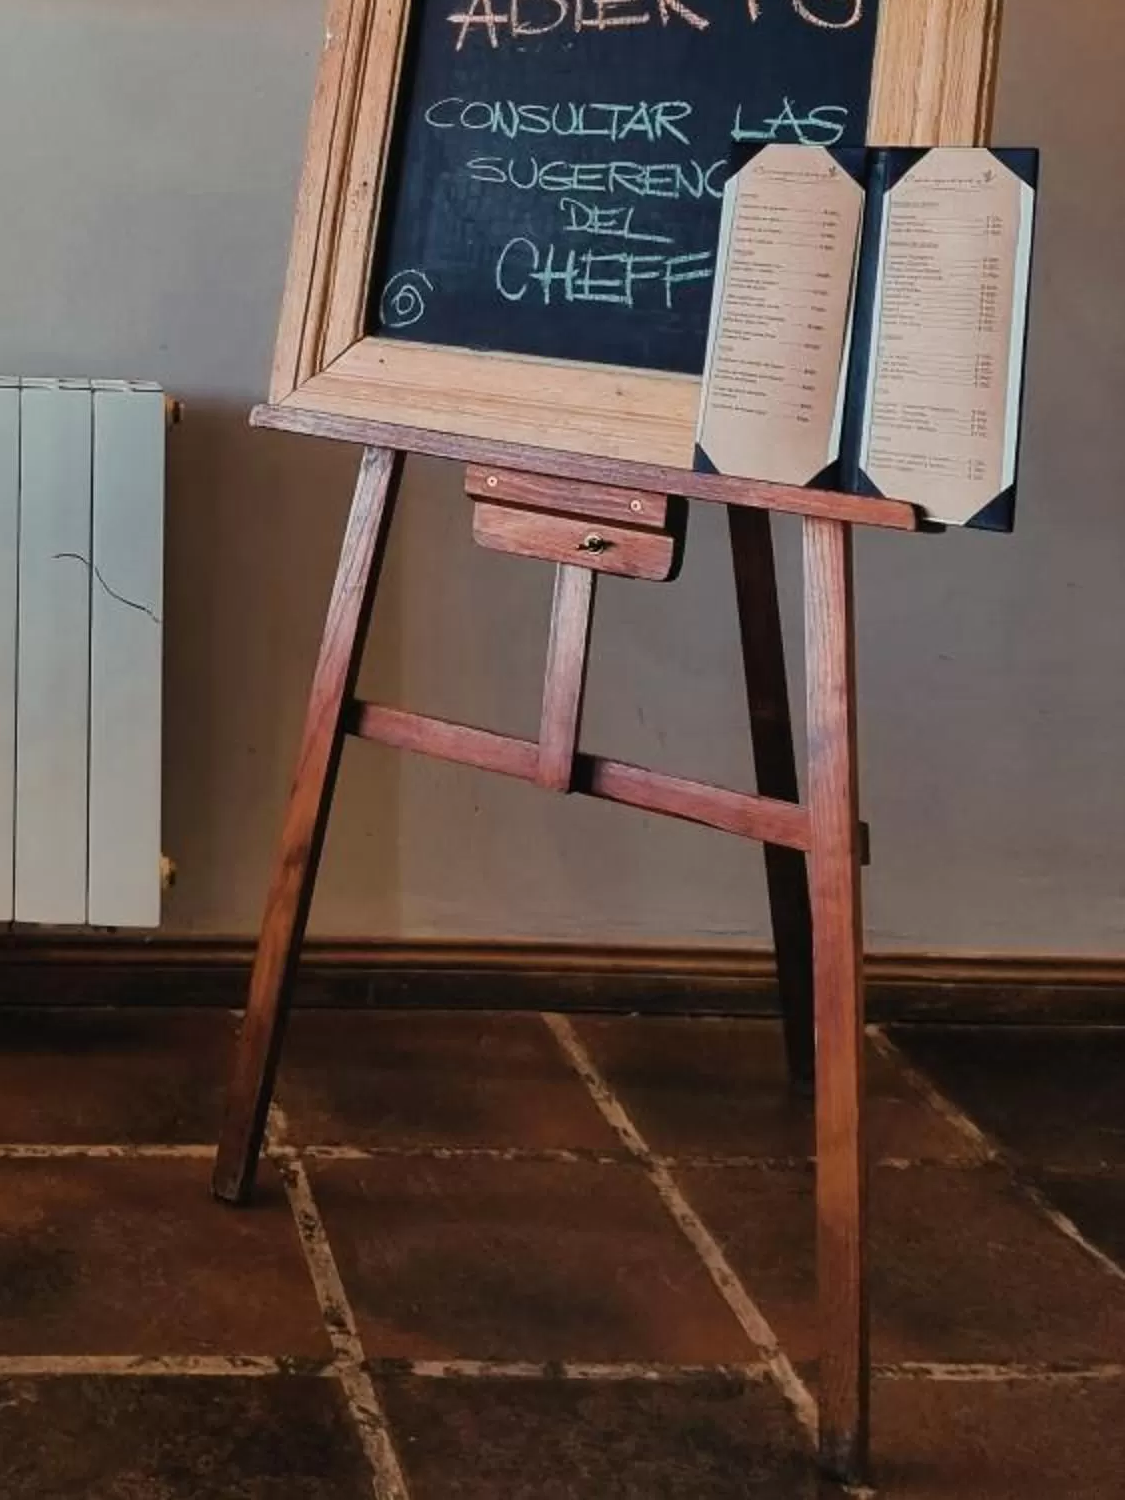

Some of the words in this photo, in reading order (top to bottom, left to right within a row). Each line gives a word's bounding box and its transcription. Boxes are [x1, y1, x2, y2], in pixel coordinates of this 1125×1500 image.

[425, 97, 692, 145] CONSULTAR
[730, 97, 848, 146] LAS
[466, 155, 728, 198] SUGERENC
[559, 197, 674, 244] DEL
[496, 237, 714, 309] CHEFF
